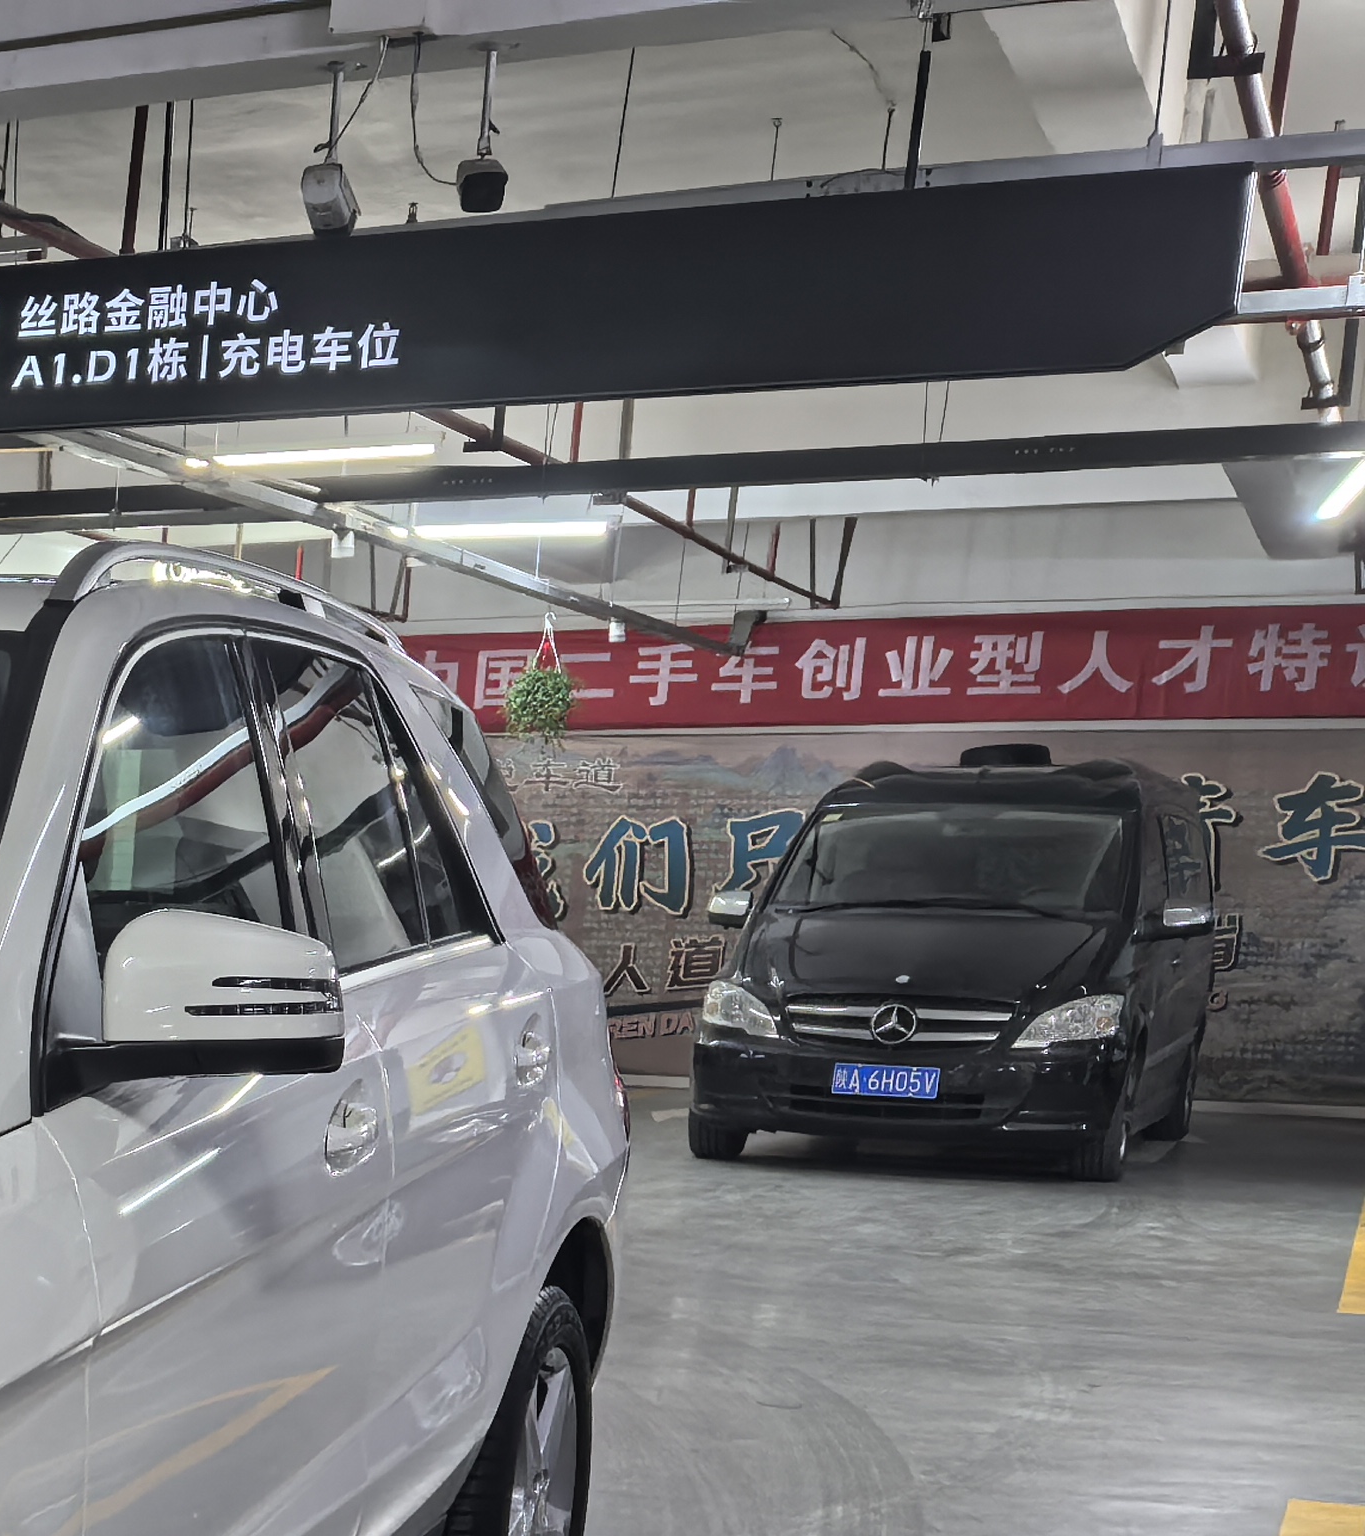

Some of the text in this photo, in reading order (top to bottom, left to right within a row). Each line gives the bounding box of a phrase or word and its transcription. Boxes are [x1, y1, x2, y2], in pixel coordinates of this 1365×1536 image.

[18, 278, 279, 338] 丝路金融中心
[218, 321, 401, 378] 充电车位
[423, 621, 1365, 708] 国二手车创业型人才特
